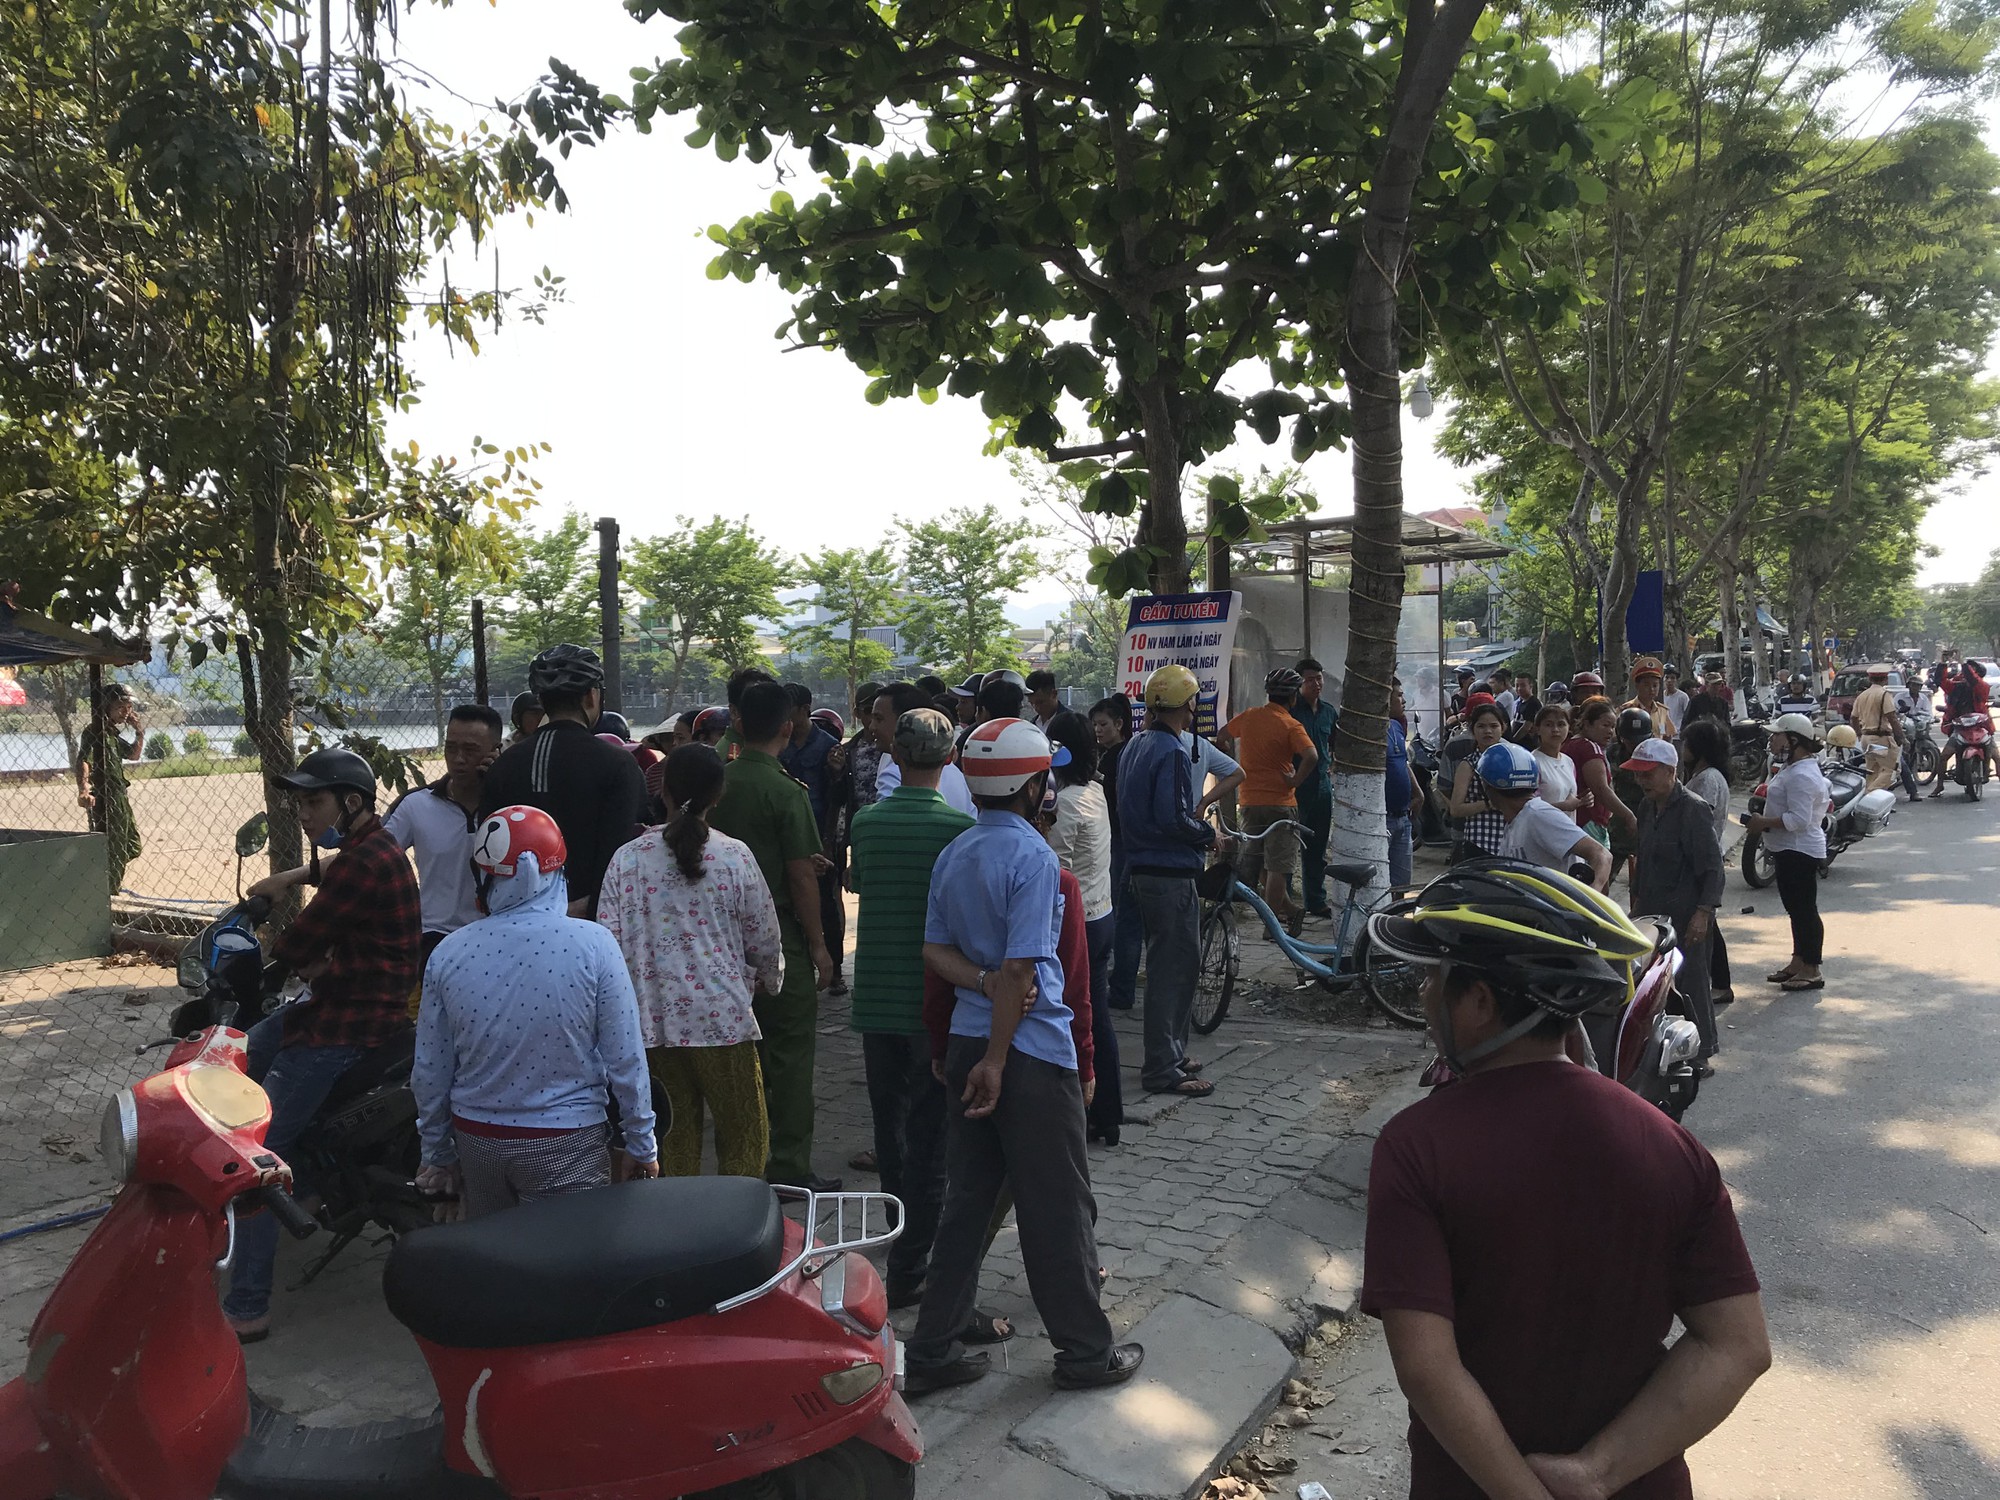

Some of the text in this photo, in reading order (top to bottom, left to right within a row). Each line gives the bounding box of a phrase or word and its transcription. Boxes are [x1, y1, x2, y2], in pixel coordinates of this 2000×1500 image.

[1130, 631, 1222, 650] 10 NV NAM LÀM CẢ NGÀY
[1127, 655, 1144, 673] 10
[1144, 659, 1156, 672] NV
[1200, 654, 1220, 668] NGÀY
[1124, 680, 1141, 698] 20
